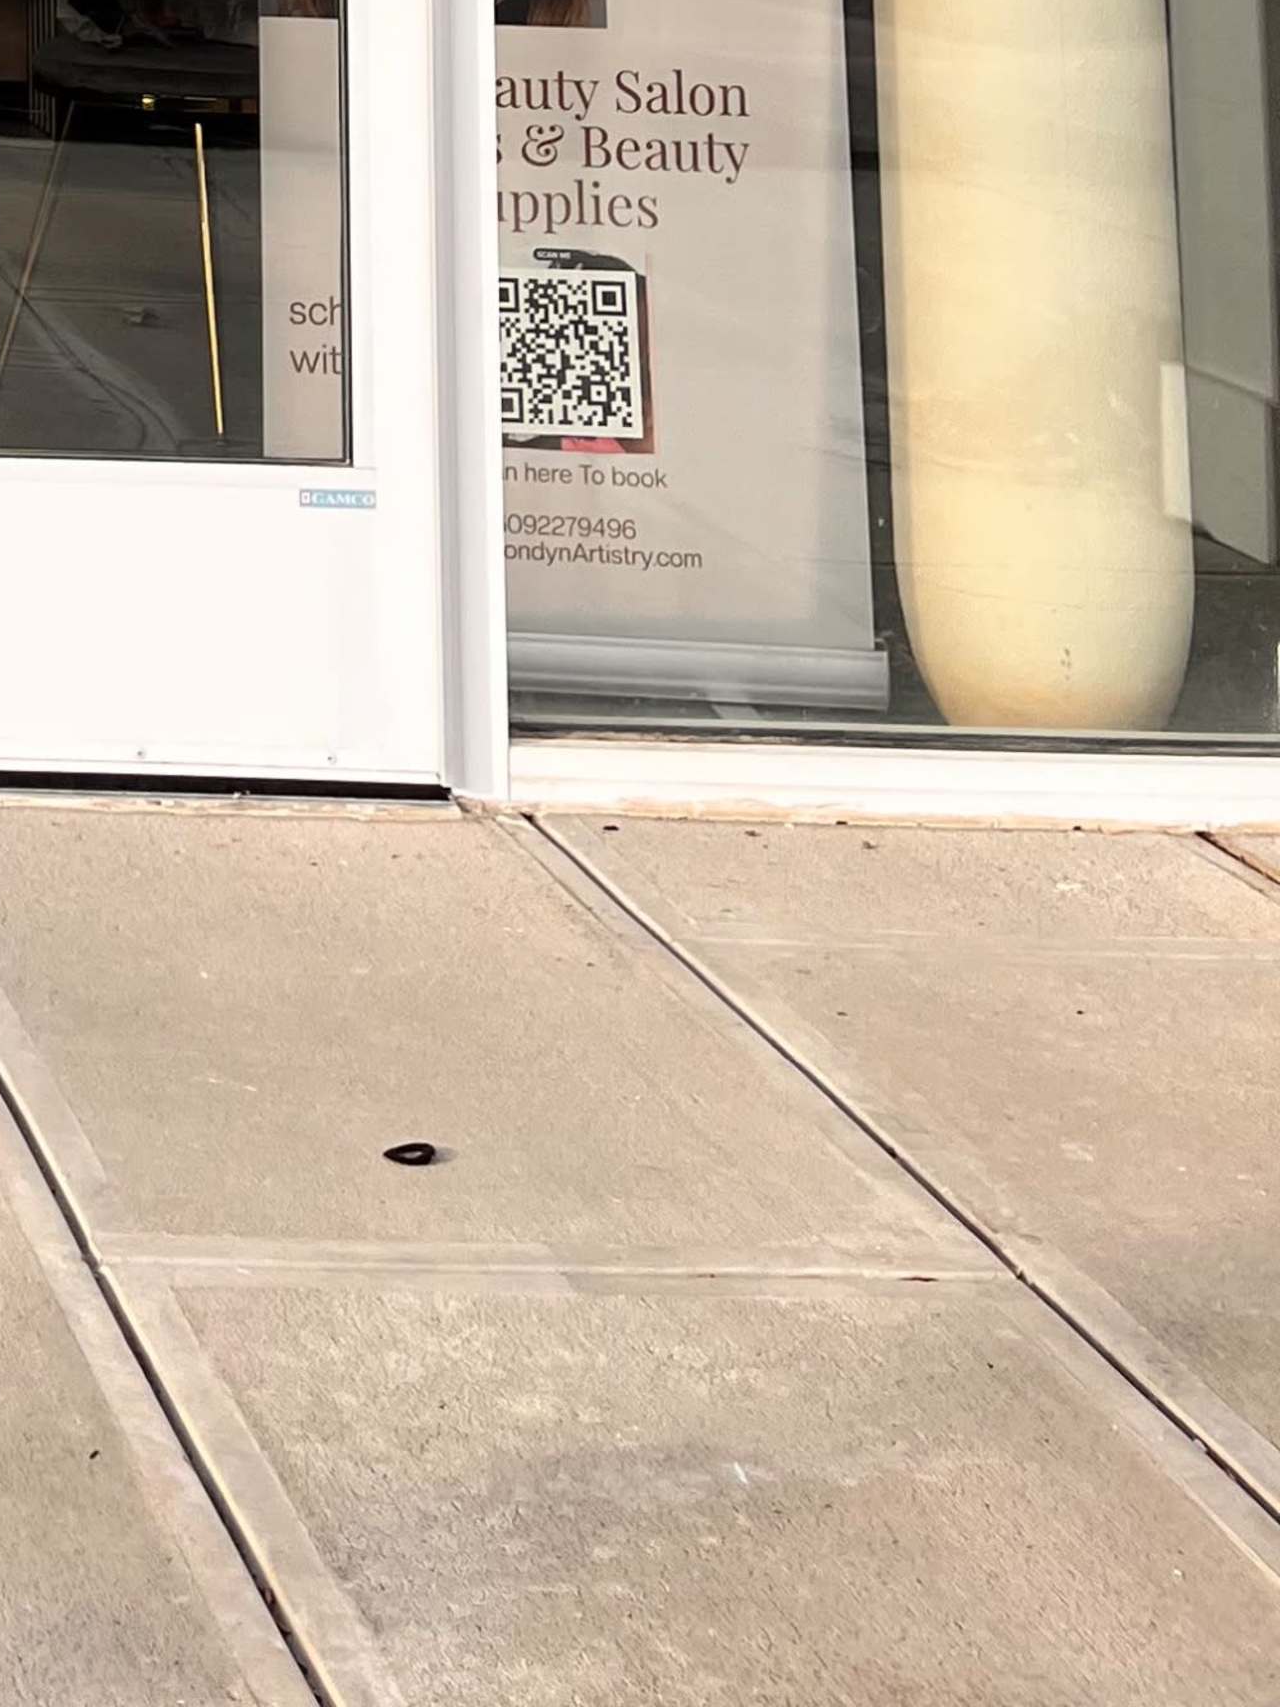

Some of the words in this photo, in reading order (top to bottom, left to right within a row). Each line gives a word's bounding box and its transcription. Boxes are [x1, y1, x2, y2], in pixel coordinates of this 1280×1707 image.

[615, 70, 750, 117] Salon
[522, 124, 564, 167] &
[581, 126, 750, 184] Beauty
[524, 463, 572, 484] here
[579, 465, 605, 485] To
[612, 466, 668, 488] book
[312, 492, 375, 506] GAMCO
